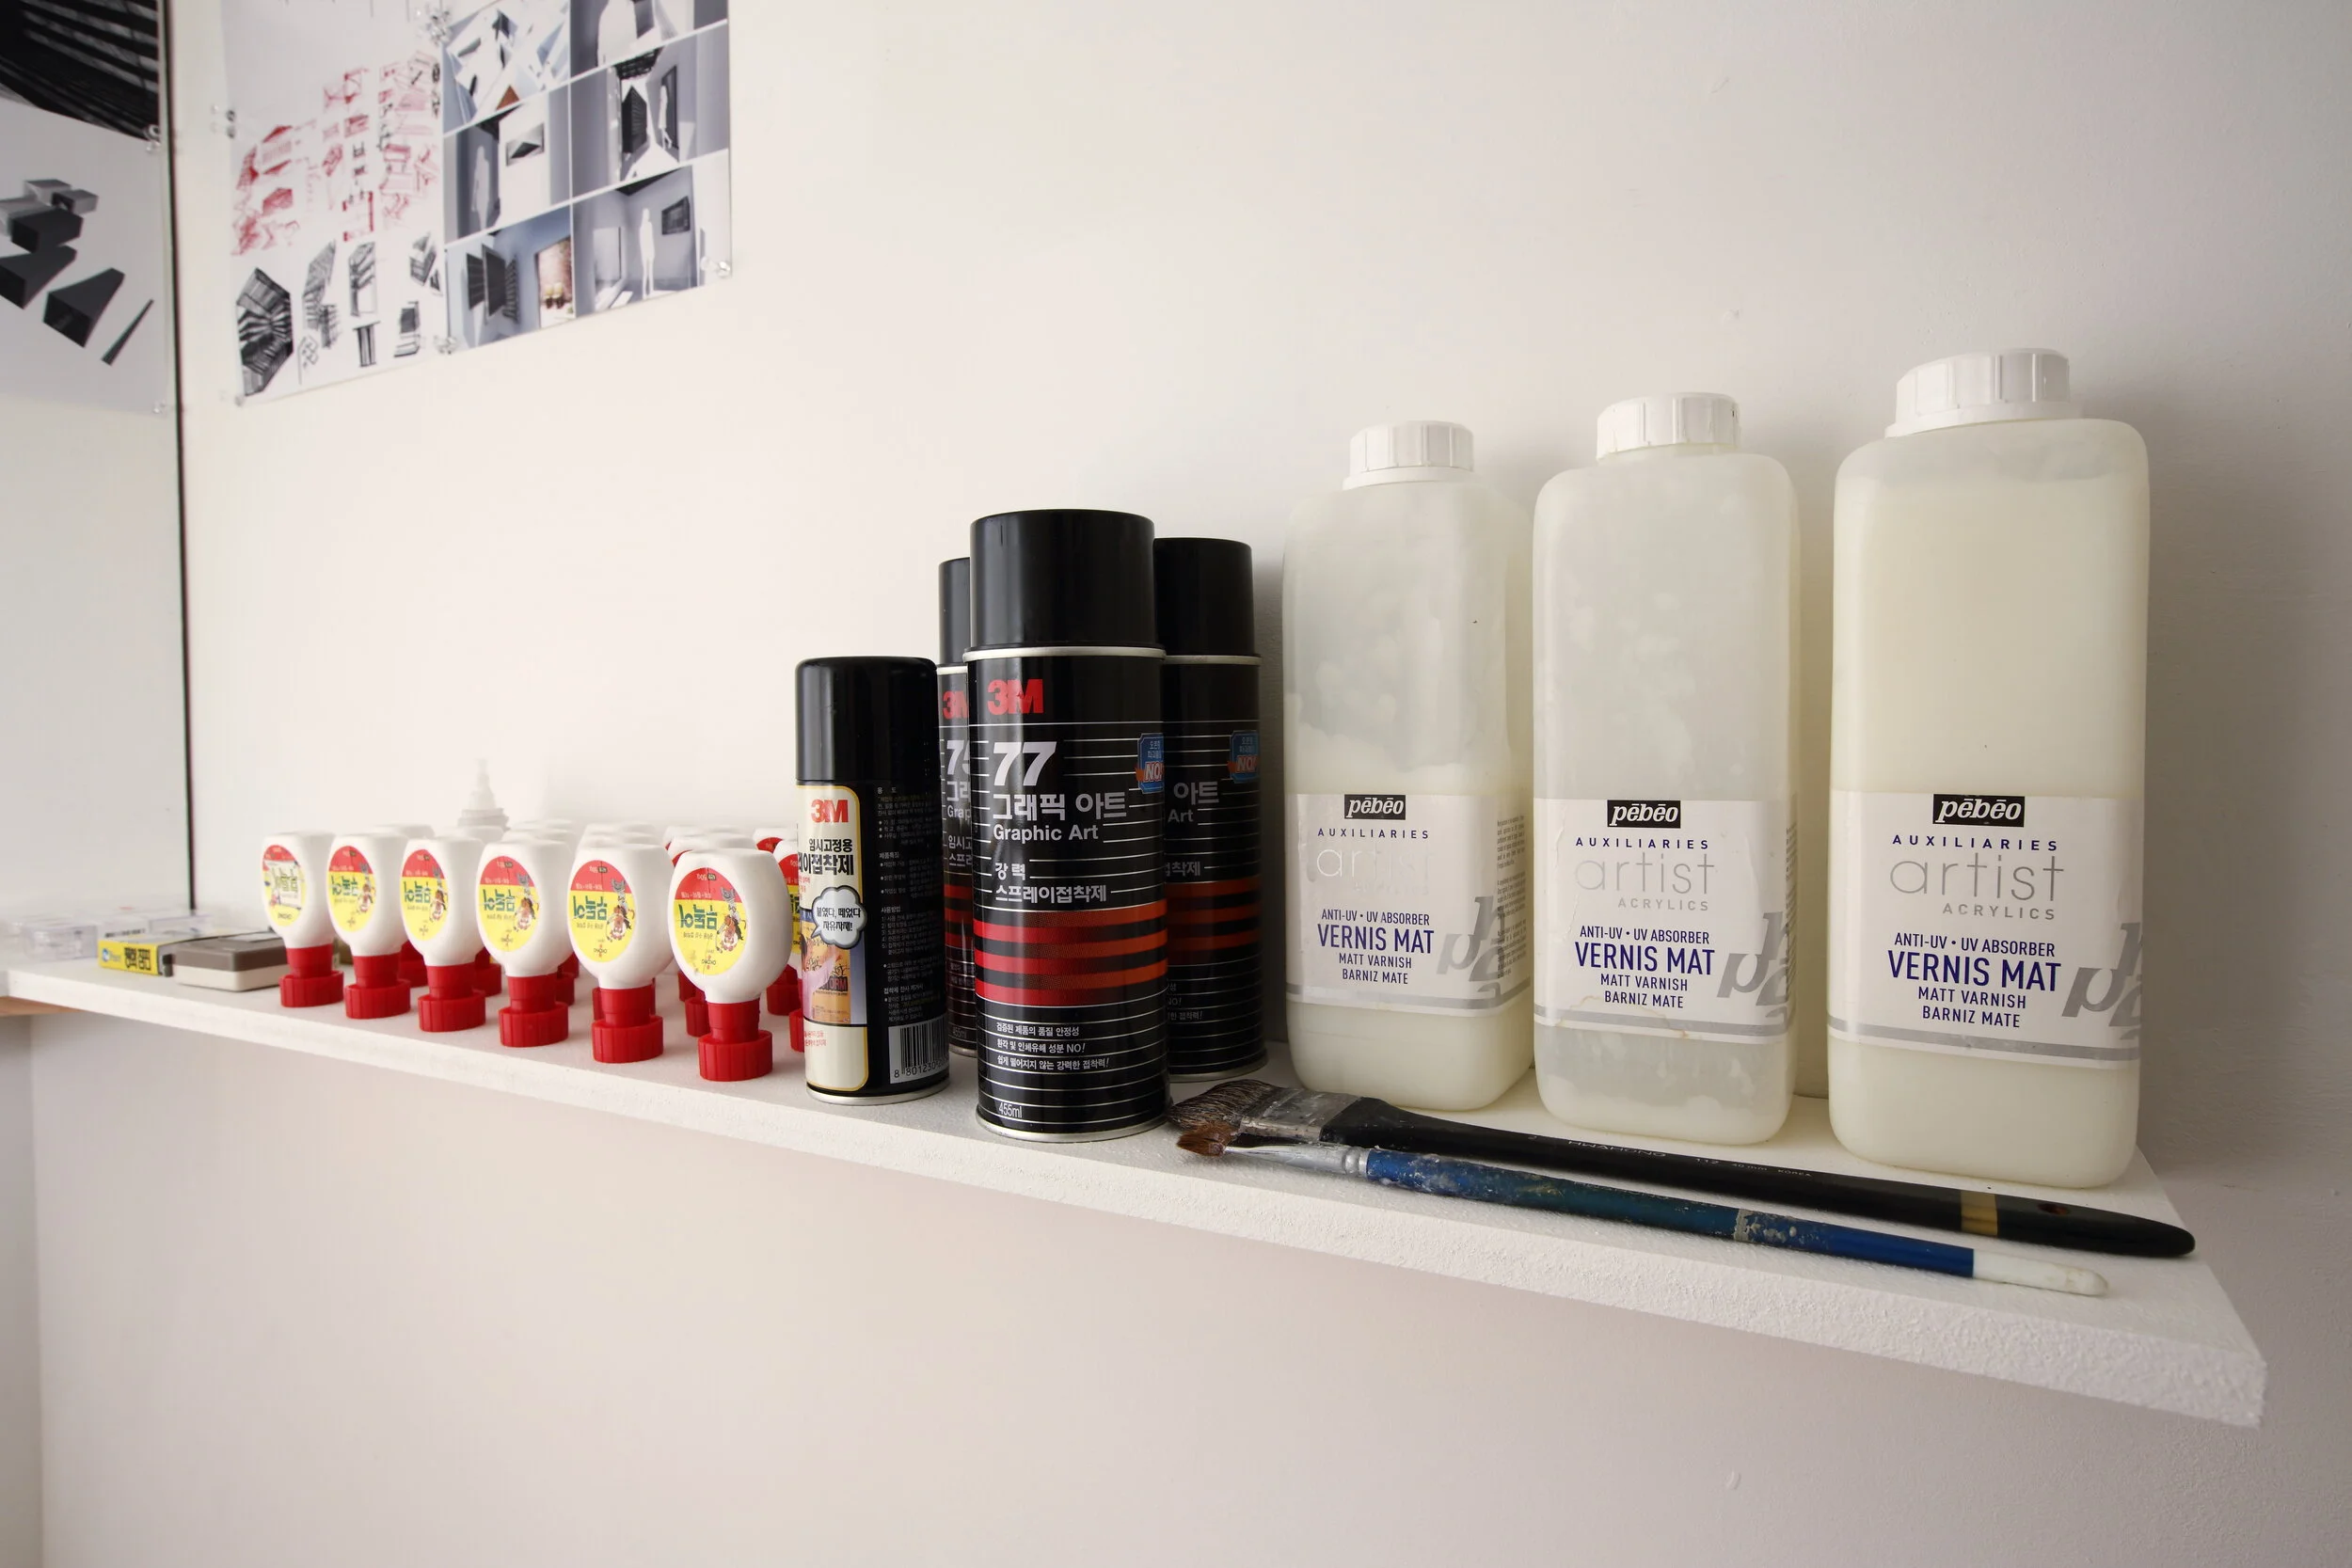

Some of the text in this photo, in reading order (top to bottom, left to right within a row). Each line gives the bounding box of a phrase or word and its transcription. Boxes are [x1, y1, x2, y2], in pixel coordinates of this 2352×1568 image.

[987, 678, 1044, 716] 3M
[993, 741, 1057, 787] 77
[1172, 781, 1220, 806] 아트
[811, 799, 850, 824] 3M
[992, 791, 1127, 822] 그래픽 아트
[1167, 808, 1195, 823] Art
[993, 824, 1099, 845] Graphic Art
[1317, 828, 1429, 840] AUXILIARIES
[1575, 837, 1708, 849] AUXILIARIES
[1891, 834, 2058, 851] AUXILIARIES
[808, 838, 853, 853] 임시고정용
[1575, 851, 1715, 895] artist
[1889, 852, 2064, 901] artist
[994, 884, 1108, 905] 스프레이접착제
[837, 907, 862, 919] 떼었다
[1617, 897, 1708, 911] ACRYLICS
[1942, 902, 2056, 921] ACRYLICS
[822, 920, 853, 932] 자유자재!
[1321, 909, 1430, 926] ANTI-UV UV ABSORBER
[1317, 924, 1435, 954] VERNIS MAT
[1579, 925, 1710, 945] ANTI-UV UV ABSORBER
[1894, 932, 2056, 958] ANTI-UV UV ABSORBER
[1338, 953, 1412, 969] MATT VARNISH
[1574, 942, 1715, 975] VERNIS MAT
[1342, 969, 1408, 985] BARNIZ MATE
[1887, 949, 2062, 992] VERNIS MAT
[1600, 974, 1689, 992] MATT VARNISH
[1604, 990, 1684, 1009] BARNIZ MATE
[1917, 986, 2026, 1009] MATT VARNISH
[1922, 1006, 2021, 1028] BARNIZ MATE
[996, 1022, 1080, 1037] 검증된 제품의 품질 안정성
[997, 1037, 1086, 1053] 환각 및 인체유해 성분 NO!
[997, 1054, 1110, 1070] 쉽게 떨어지지 않는 강력한 접착력!
[998, 1102, 1023, 1119] 455ml
[1567, 1140, 1666, 1157] HWAHONG
[1777, 1168, 1813, 1178] KOREA
